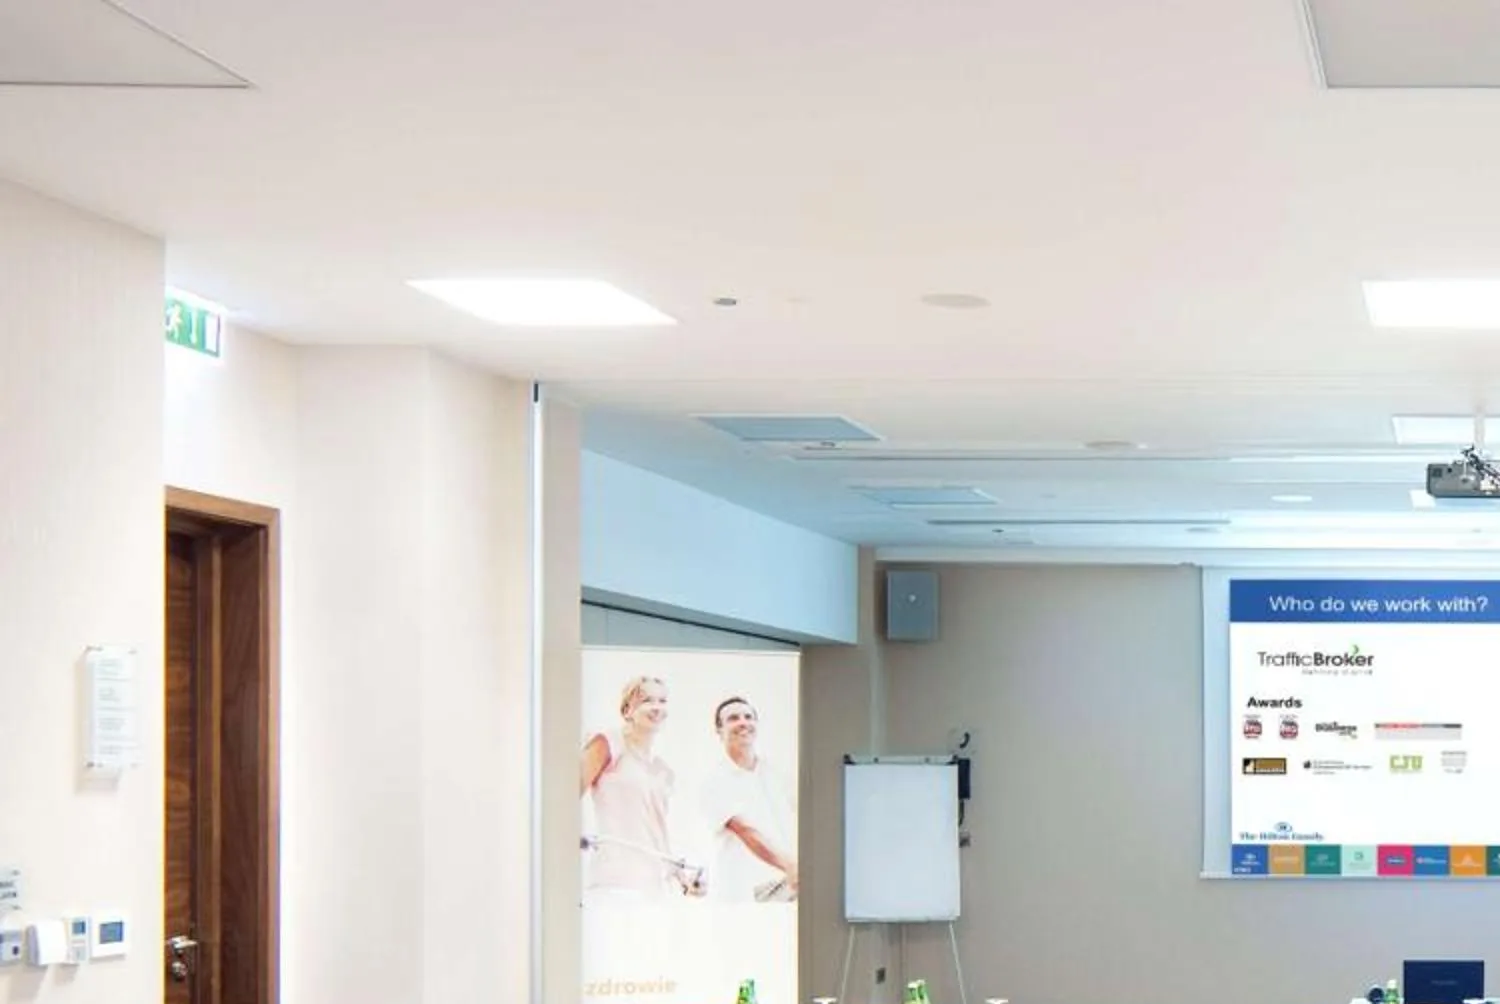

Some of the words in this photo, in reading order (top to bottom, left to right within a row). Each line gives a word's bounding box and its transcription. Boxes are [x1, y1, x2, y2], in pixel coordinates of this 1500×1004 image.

[1269, 596, 1315, 613] Who
[1320, 596, 1345, 613] do
[1350, 600, 1379, 613] we
[1384, 596, 1432, 613] work
[1437, 595, 1489, 613] with?
[1257, 651, 1375, 668] TrafficBroker
[1246, 696, 1303, 709] Awards
[584, 976, 678, 997] zdrowie
